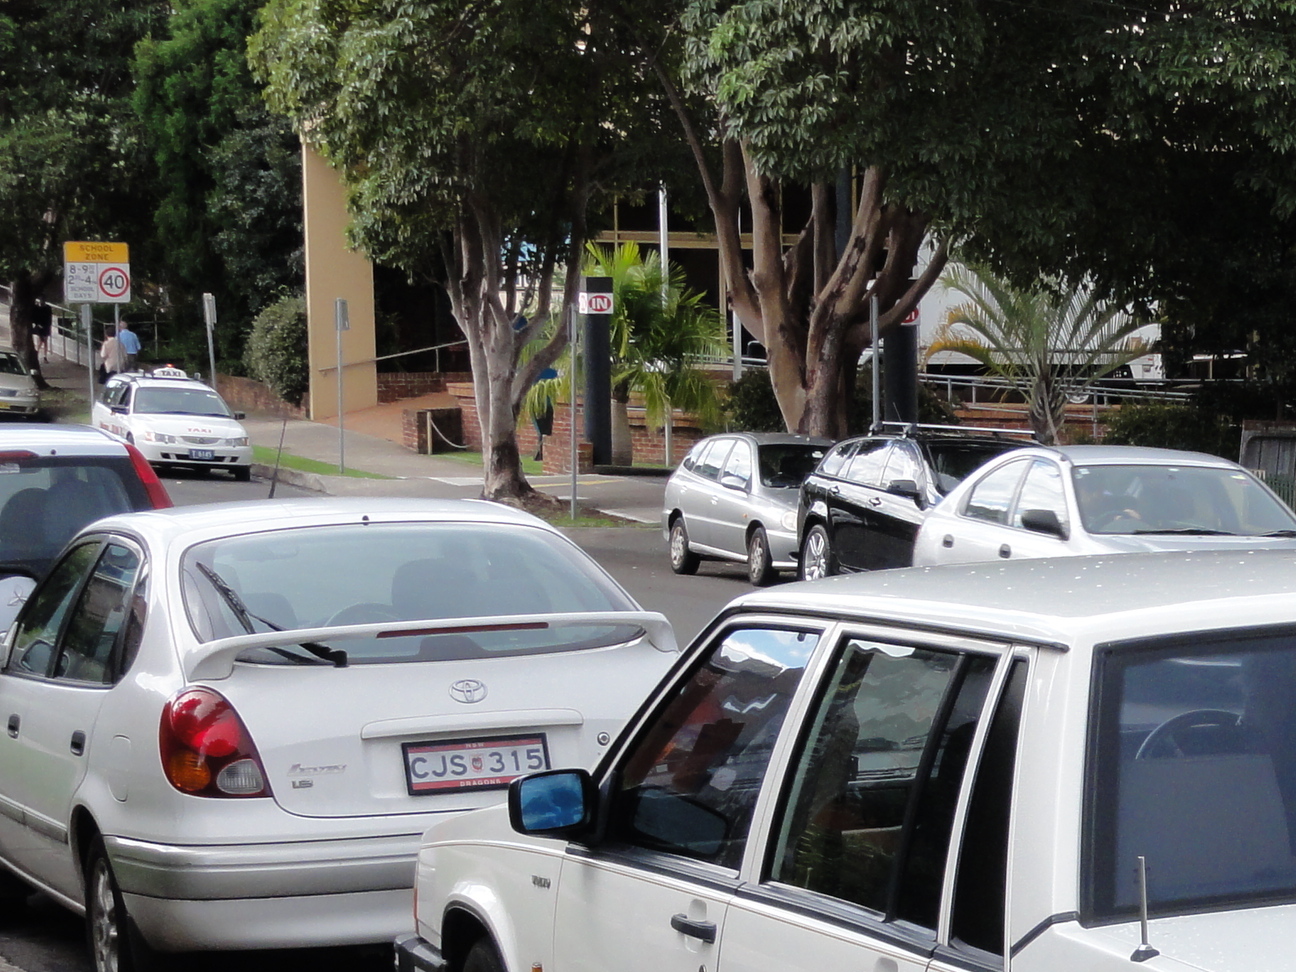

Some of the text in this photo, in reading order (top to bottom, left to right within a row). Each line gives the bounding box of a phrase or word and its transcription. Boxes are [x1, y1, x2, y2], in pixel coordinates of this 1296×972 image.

[103, 275, 125, 289] 40
[591, 297, 608, 310] IN
[410, 748, 543, 779] CJS 315
